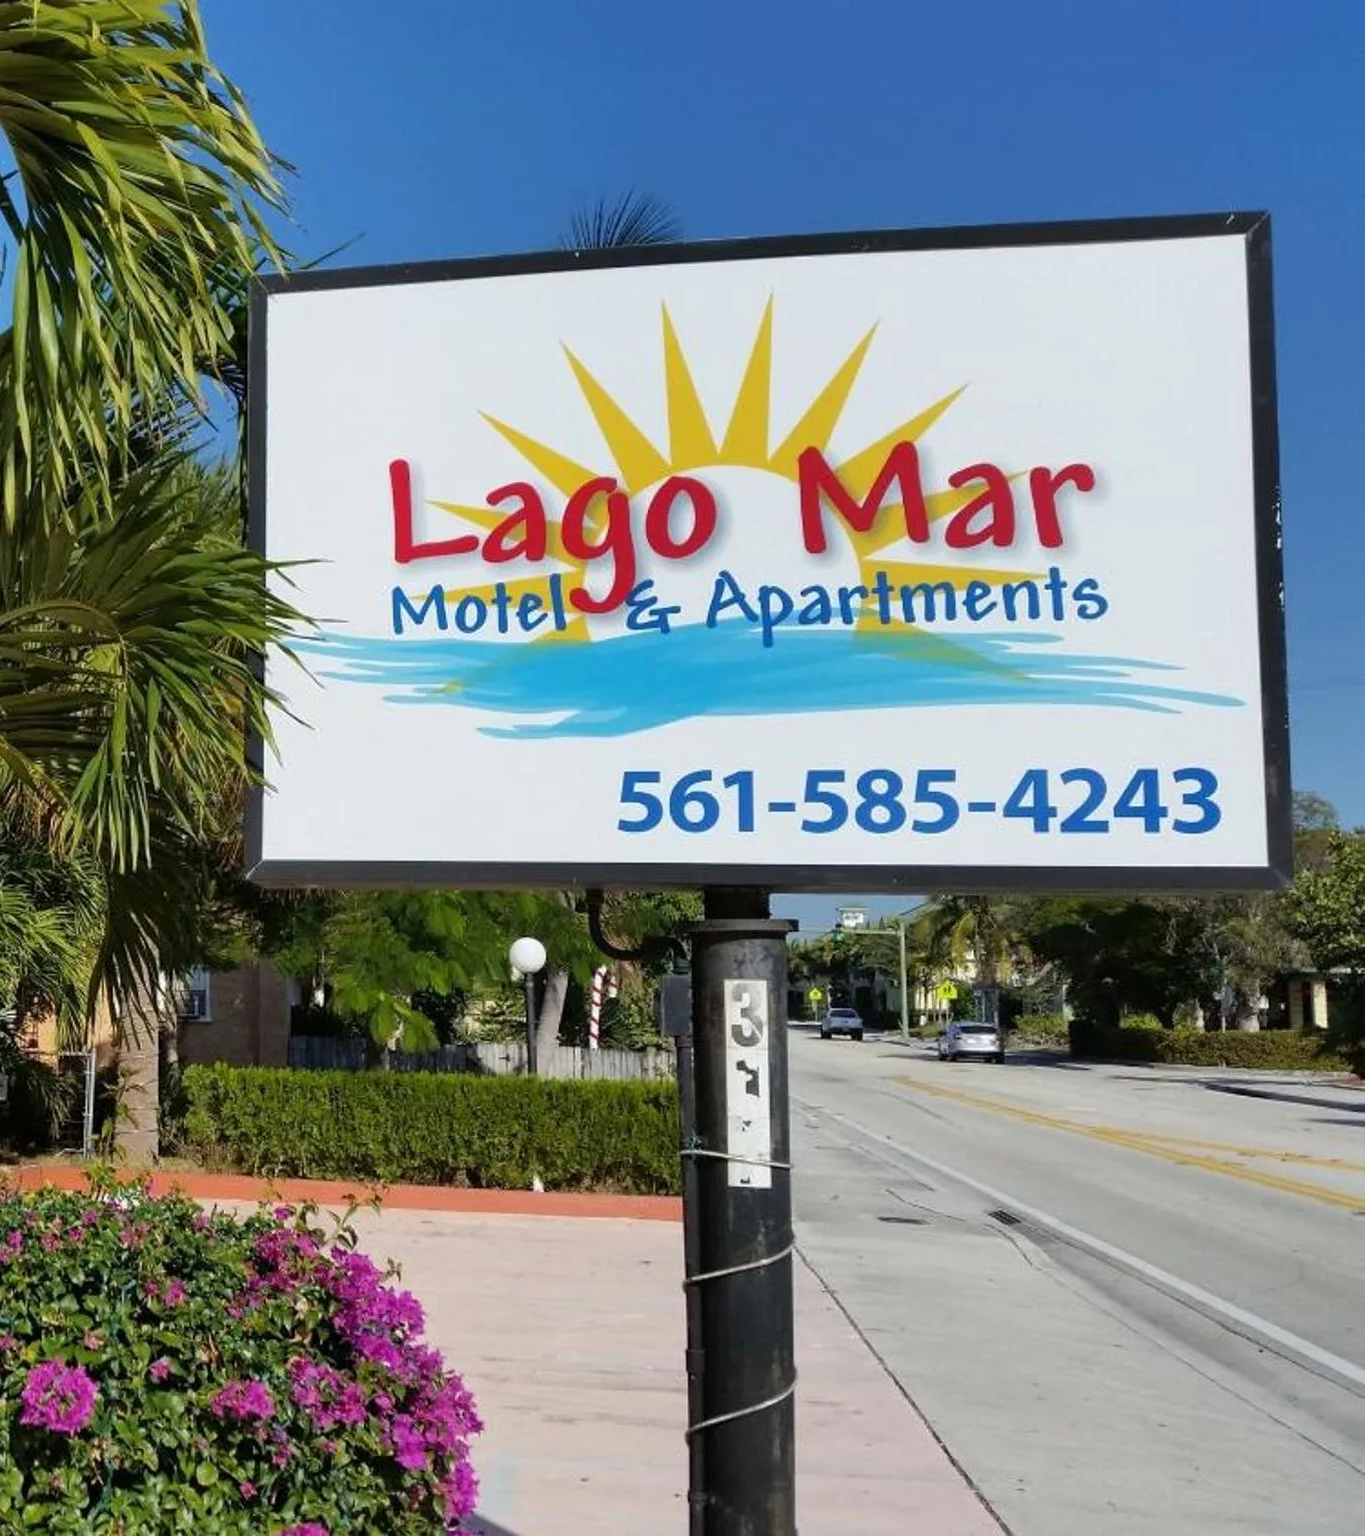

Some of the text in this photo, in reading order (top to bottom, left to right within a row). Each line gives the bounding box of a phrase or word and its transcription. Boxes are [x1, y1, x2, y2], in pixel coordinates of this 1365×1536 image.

[390, 442, 1094, 613] Lago Mar
[392, 567, 1108, 649] Motel & Apartments
[618, 767, 1221, 834] 561-585-4243
